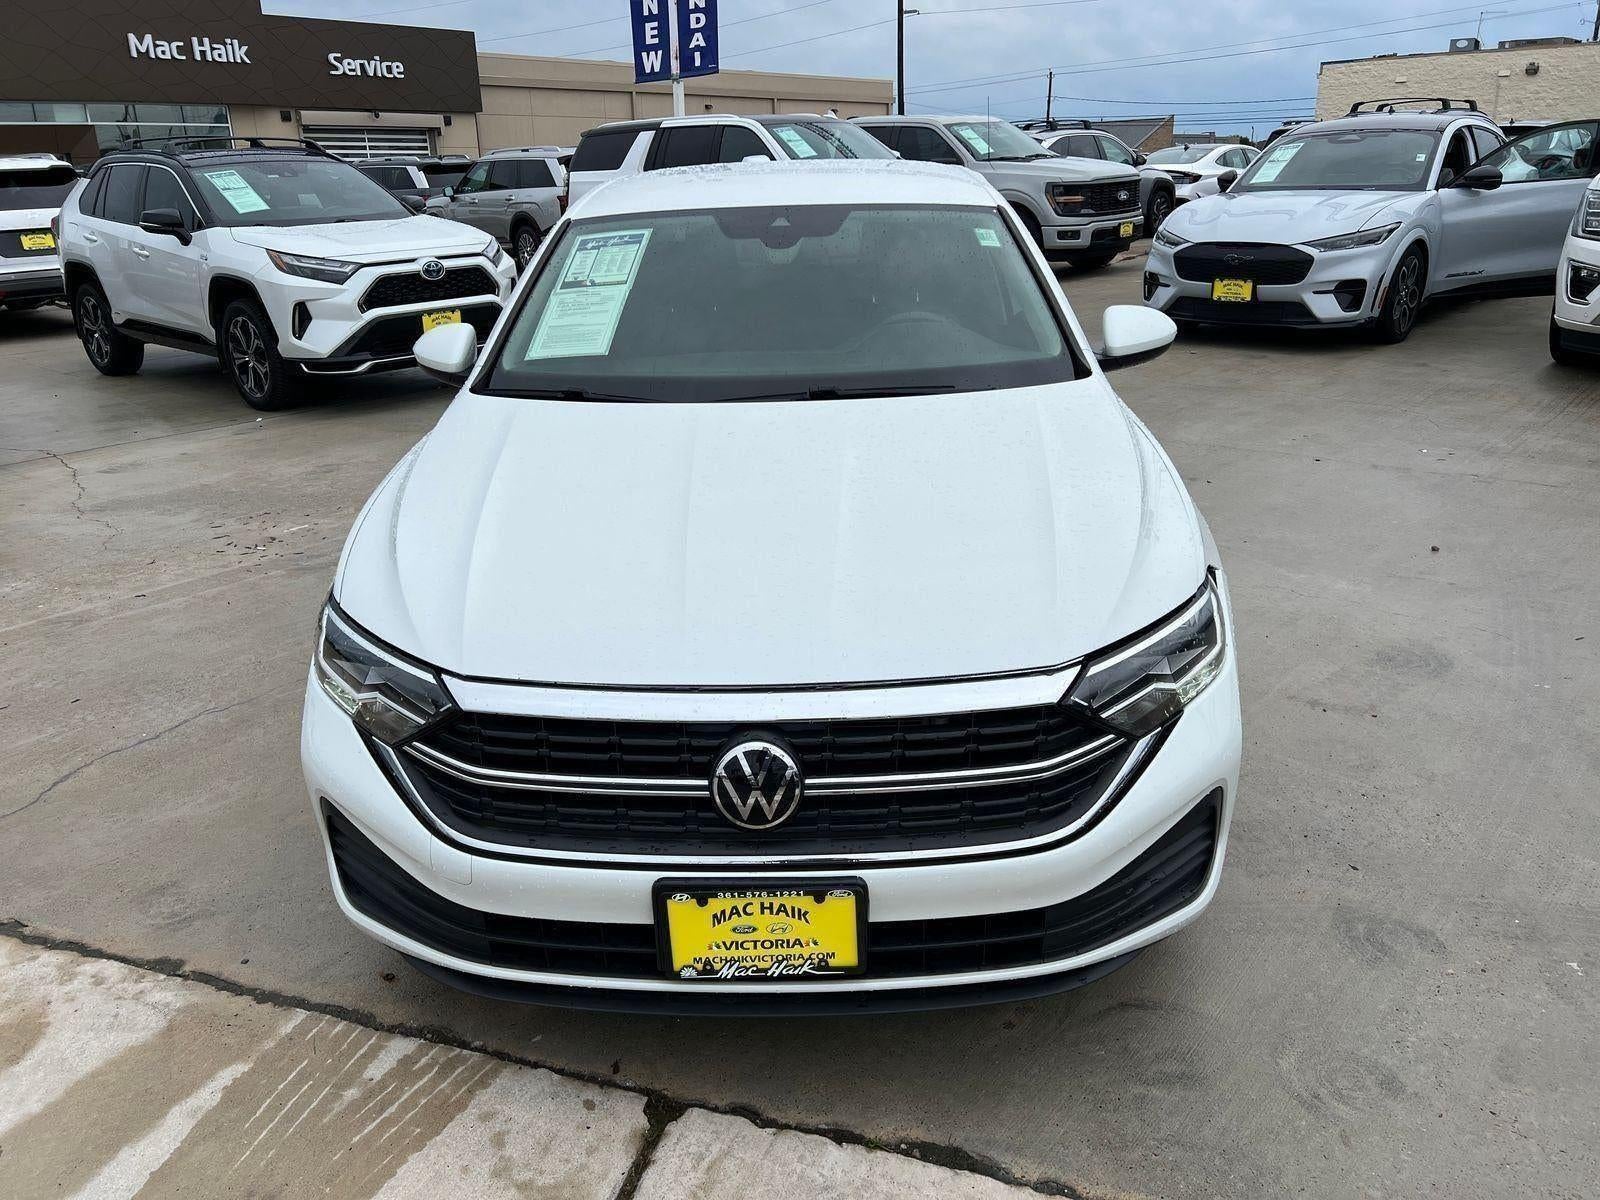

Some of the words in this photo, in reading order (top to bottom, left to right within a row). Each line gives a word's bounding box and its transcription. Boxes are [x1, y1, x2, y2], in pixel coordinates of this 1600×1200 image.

[127, 33, 186, 60] Mac
[191, 36, 252, 64] Haik
[641, 0, 662, 74] NEW
[327, 53, 404, 78] Service
[717, 890, 804, 899] 361-576-1221
[712, 902, 754, 928] MAC
[760, 901, 810, 925] HAIK
[722, 938, 804, 951] VICTORIA
[717, 961, 761, 978] Mac
[767, 959, 815, 977] Haik
